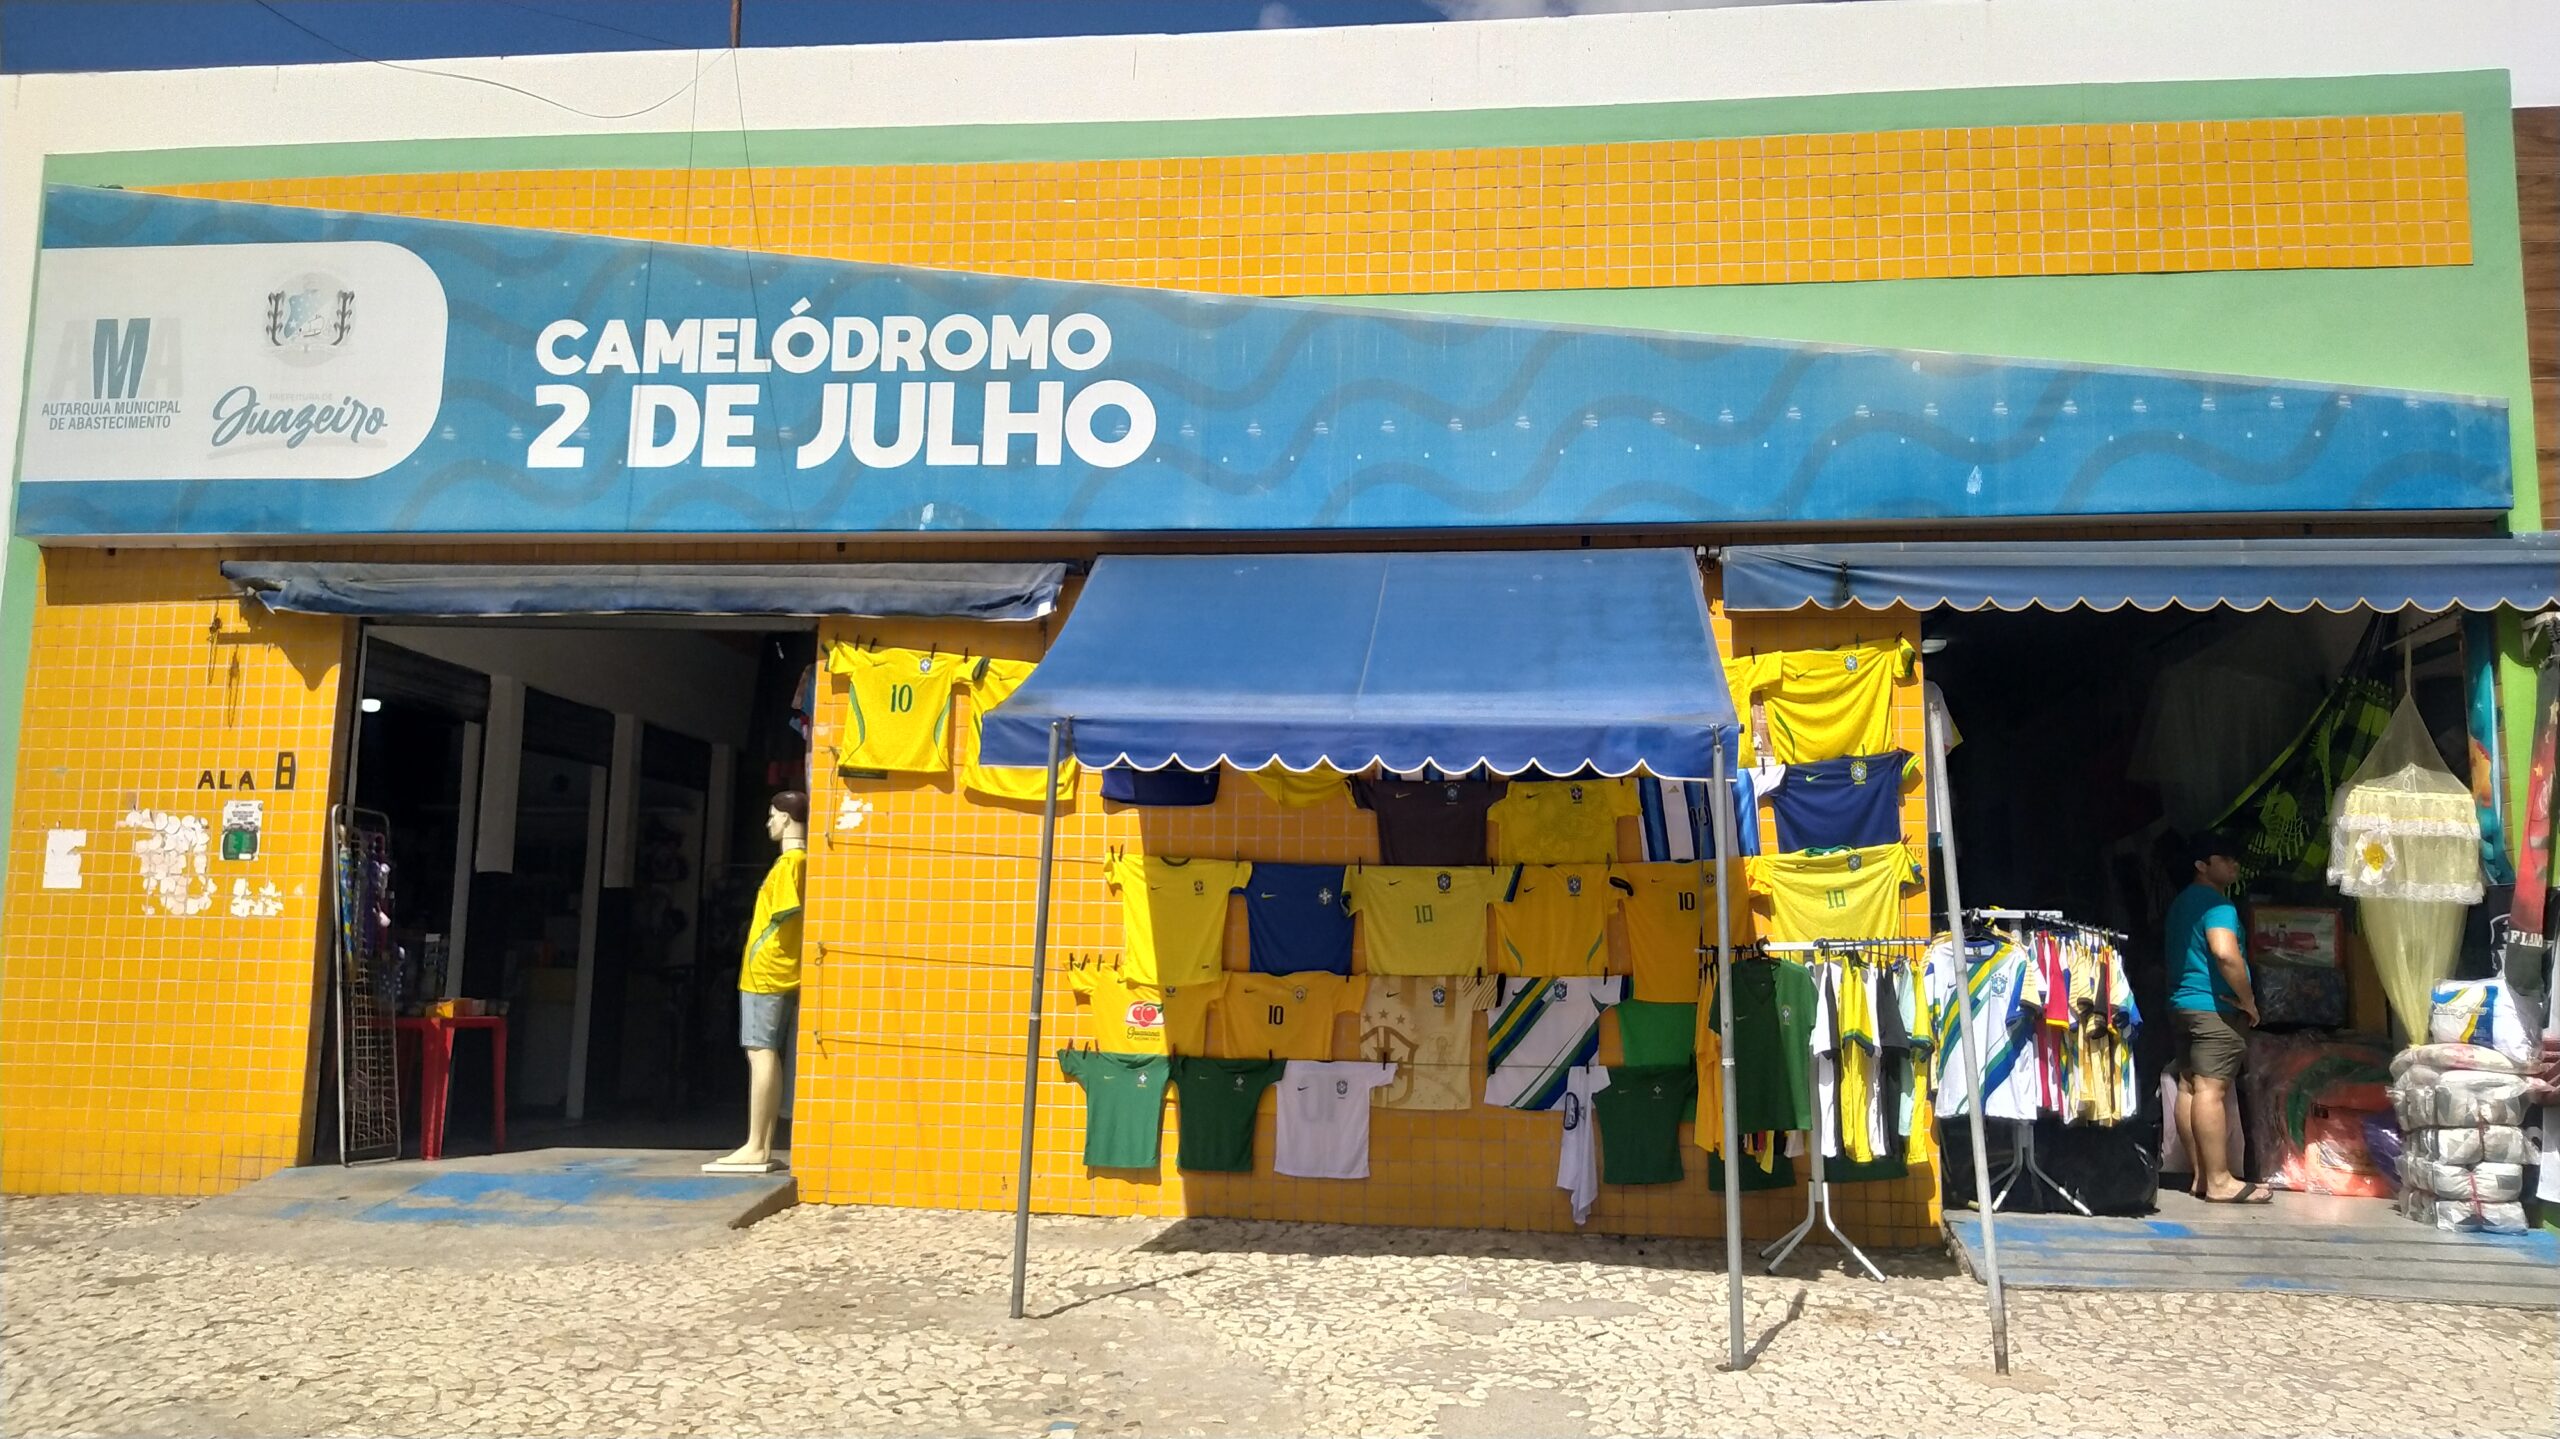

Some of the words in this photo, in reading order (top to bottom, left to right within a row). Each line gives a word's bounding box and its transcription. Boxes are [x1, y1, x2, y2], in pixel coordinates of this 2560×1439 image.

[535, 296, 1112, 375] CAMELÓDROMO
[42, 402, 111, 416] AUTARQUIA
[114, 400, 181, 415] MUNICIPAL
[211, 385, 388, 449] Juazeiro
[49, 417, 65, 430] DE
[68, 415, 171, 430] ABASTECIMENTO
[526, 383, 591, 468] 2
[627, 383, 760, 468] DE
[796, 379, 1157, 469] JULHO
[891, 684, 913, 713] 10
[197, 769, 255, 791] ALA
[275, 751, 296, 790] B
[1678, 891, 1696, 911] 10
[1825, 887, 1847, 909] 10
[1414, 904, 1433, 924] 10
[1268, 1004, 1284, 1026] 10
